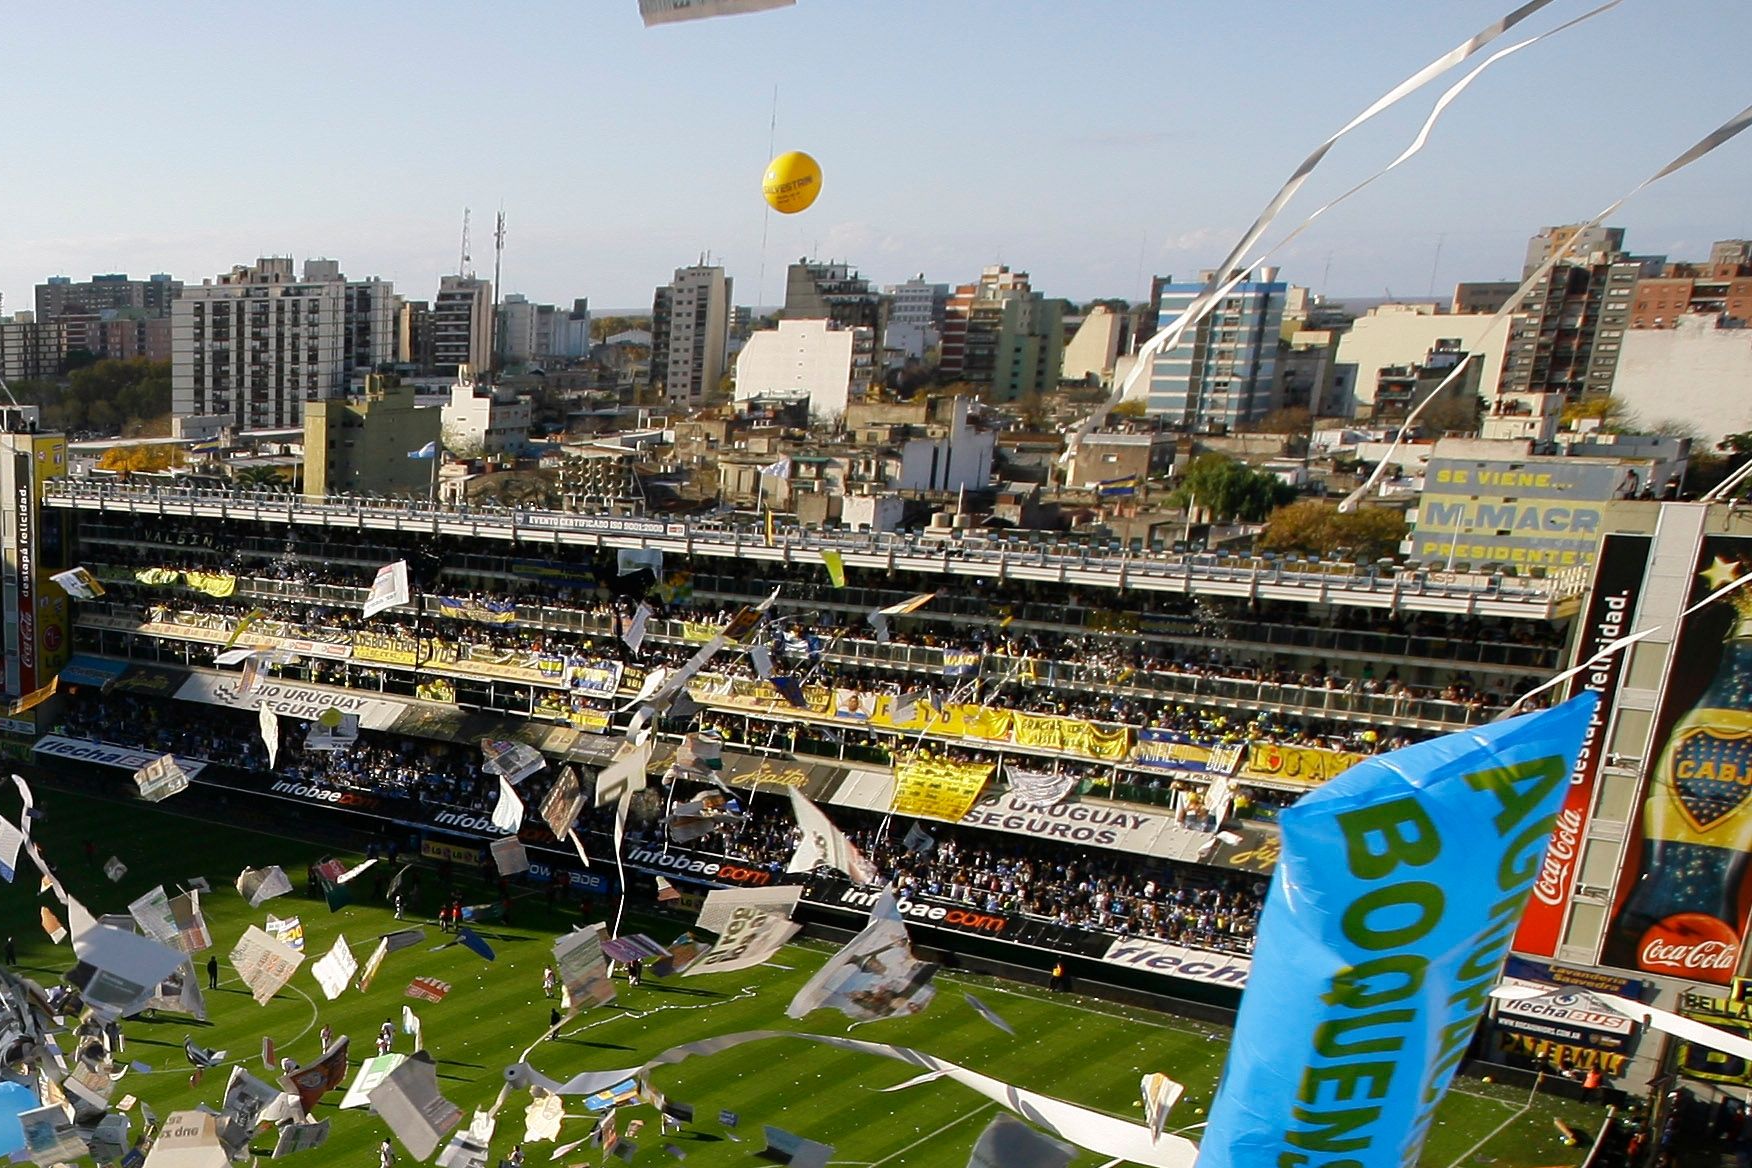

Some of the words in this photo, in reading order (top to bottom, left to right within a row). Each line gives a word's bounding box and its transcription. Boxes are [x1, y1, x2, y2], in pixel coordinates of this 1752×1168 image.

[1436, 469, 1468, 484] SE
[45, 655, 62, 667] LG
[282, 688, 368, 710] URUGUAY
[1676, 760, 1752, 787] CABJ
[961, 809, 1118, 846] SEGUROS
[1642, 938, 1737, 968] Coca-Cola
